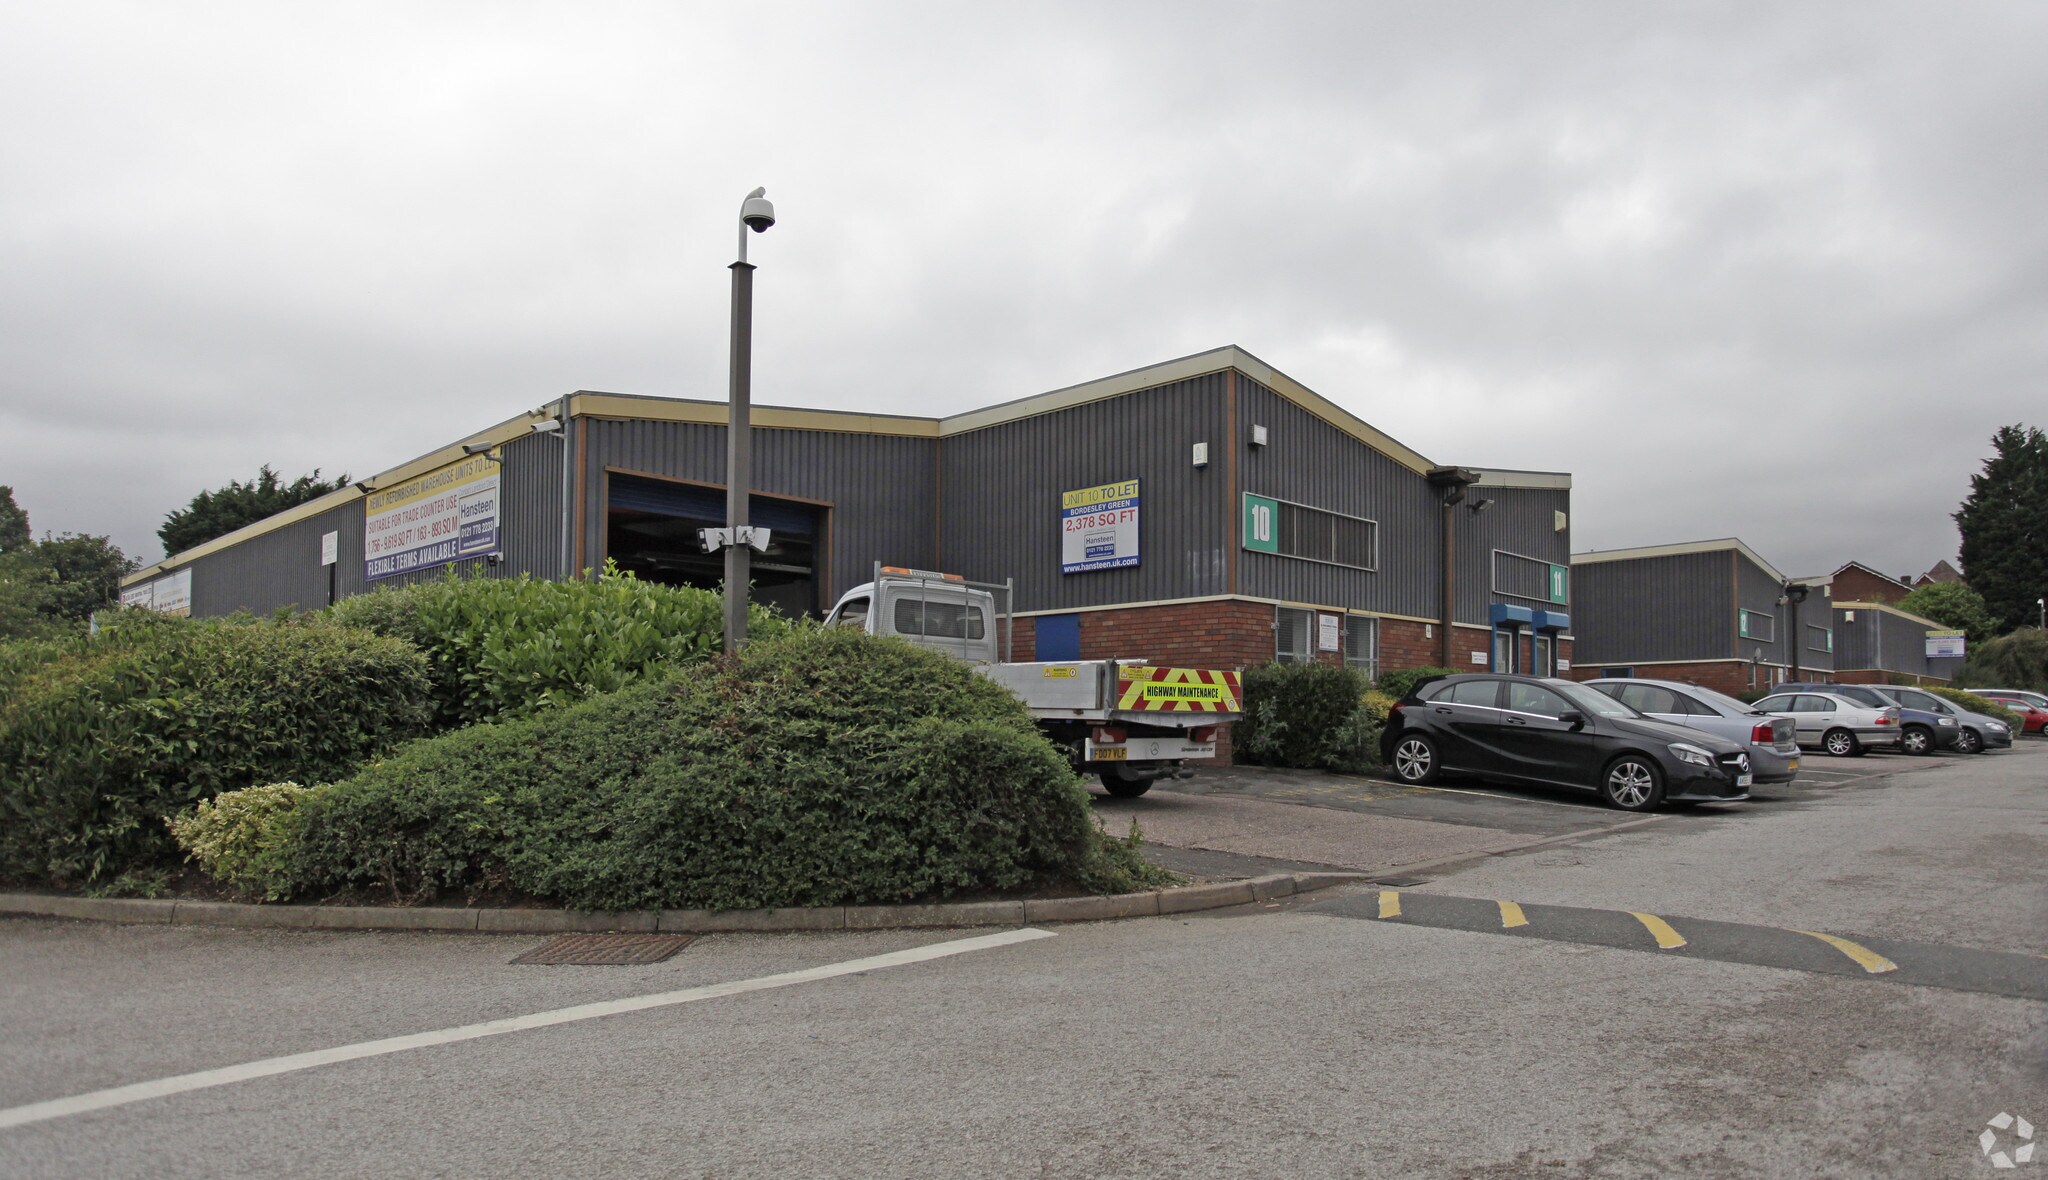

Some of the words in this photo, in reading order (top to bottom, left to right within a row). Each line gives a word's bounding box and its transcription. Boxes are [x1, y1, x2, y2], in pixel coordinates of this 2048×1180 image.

[369, 494, 384, 511] NEWLY
[386, 481, 419, 505] REFURBISHED
[421, 468, 453, 493] WAREHOUSE
[455, 461, 472, 480] UNITS
[475, 457, 482, 473] TO
[485, 452, 496, 470] LET
[1064, 492, 1085, 506] UNIT
[1089, 490, 1098, 501] 10
[1101, 487, 1115, 499] TO
[1118, 483, 1137, 496] LET
[368, 516, 390, 534] SUITABLE
[391, 512, 401, 527] FOR
[402, 506, 418, 524] TRADE
[420, 498, 444, 518] COUNTER
[445, 494, 457, 511] USE
[460, 495, 493, 519] Hansteen
[1071, 503, 1106, 516] BORDESLEY
[1108, 500, 1130, 509] GREEN
[383, 533, 397, 551] 9,619
[398, 531, 405, 546] SQ
[405, 529, 412, 544] FT
[417, 524, 426, 541] 163
[431, 520, 441, 537] 893
[442, 517, 450, 534] SQ
[451, 515, 457, 531] M
[1066, 516, 1095, 533] 2,378
[1099, 513, 1115, 526] SQ
[1120, 510, 1135, 523] FT
[1252, 504, 1270, 542] 10
[1086, 536, 1113, 544] Hansteen
[368, 556, 394, 576] FLEXIBLE
[395, 550, 417, 570] TERMS
[418, 540, 456, 565] AVAILABLE
[1064, 558, 1137, 573] www.hansteen.uk.com
[1554, 571, 1562, 596] 11
[1147, 686, 1176, 697] HIGHWAY
[1178, 687, 1219, 698] MAINTENANCE
